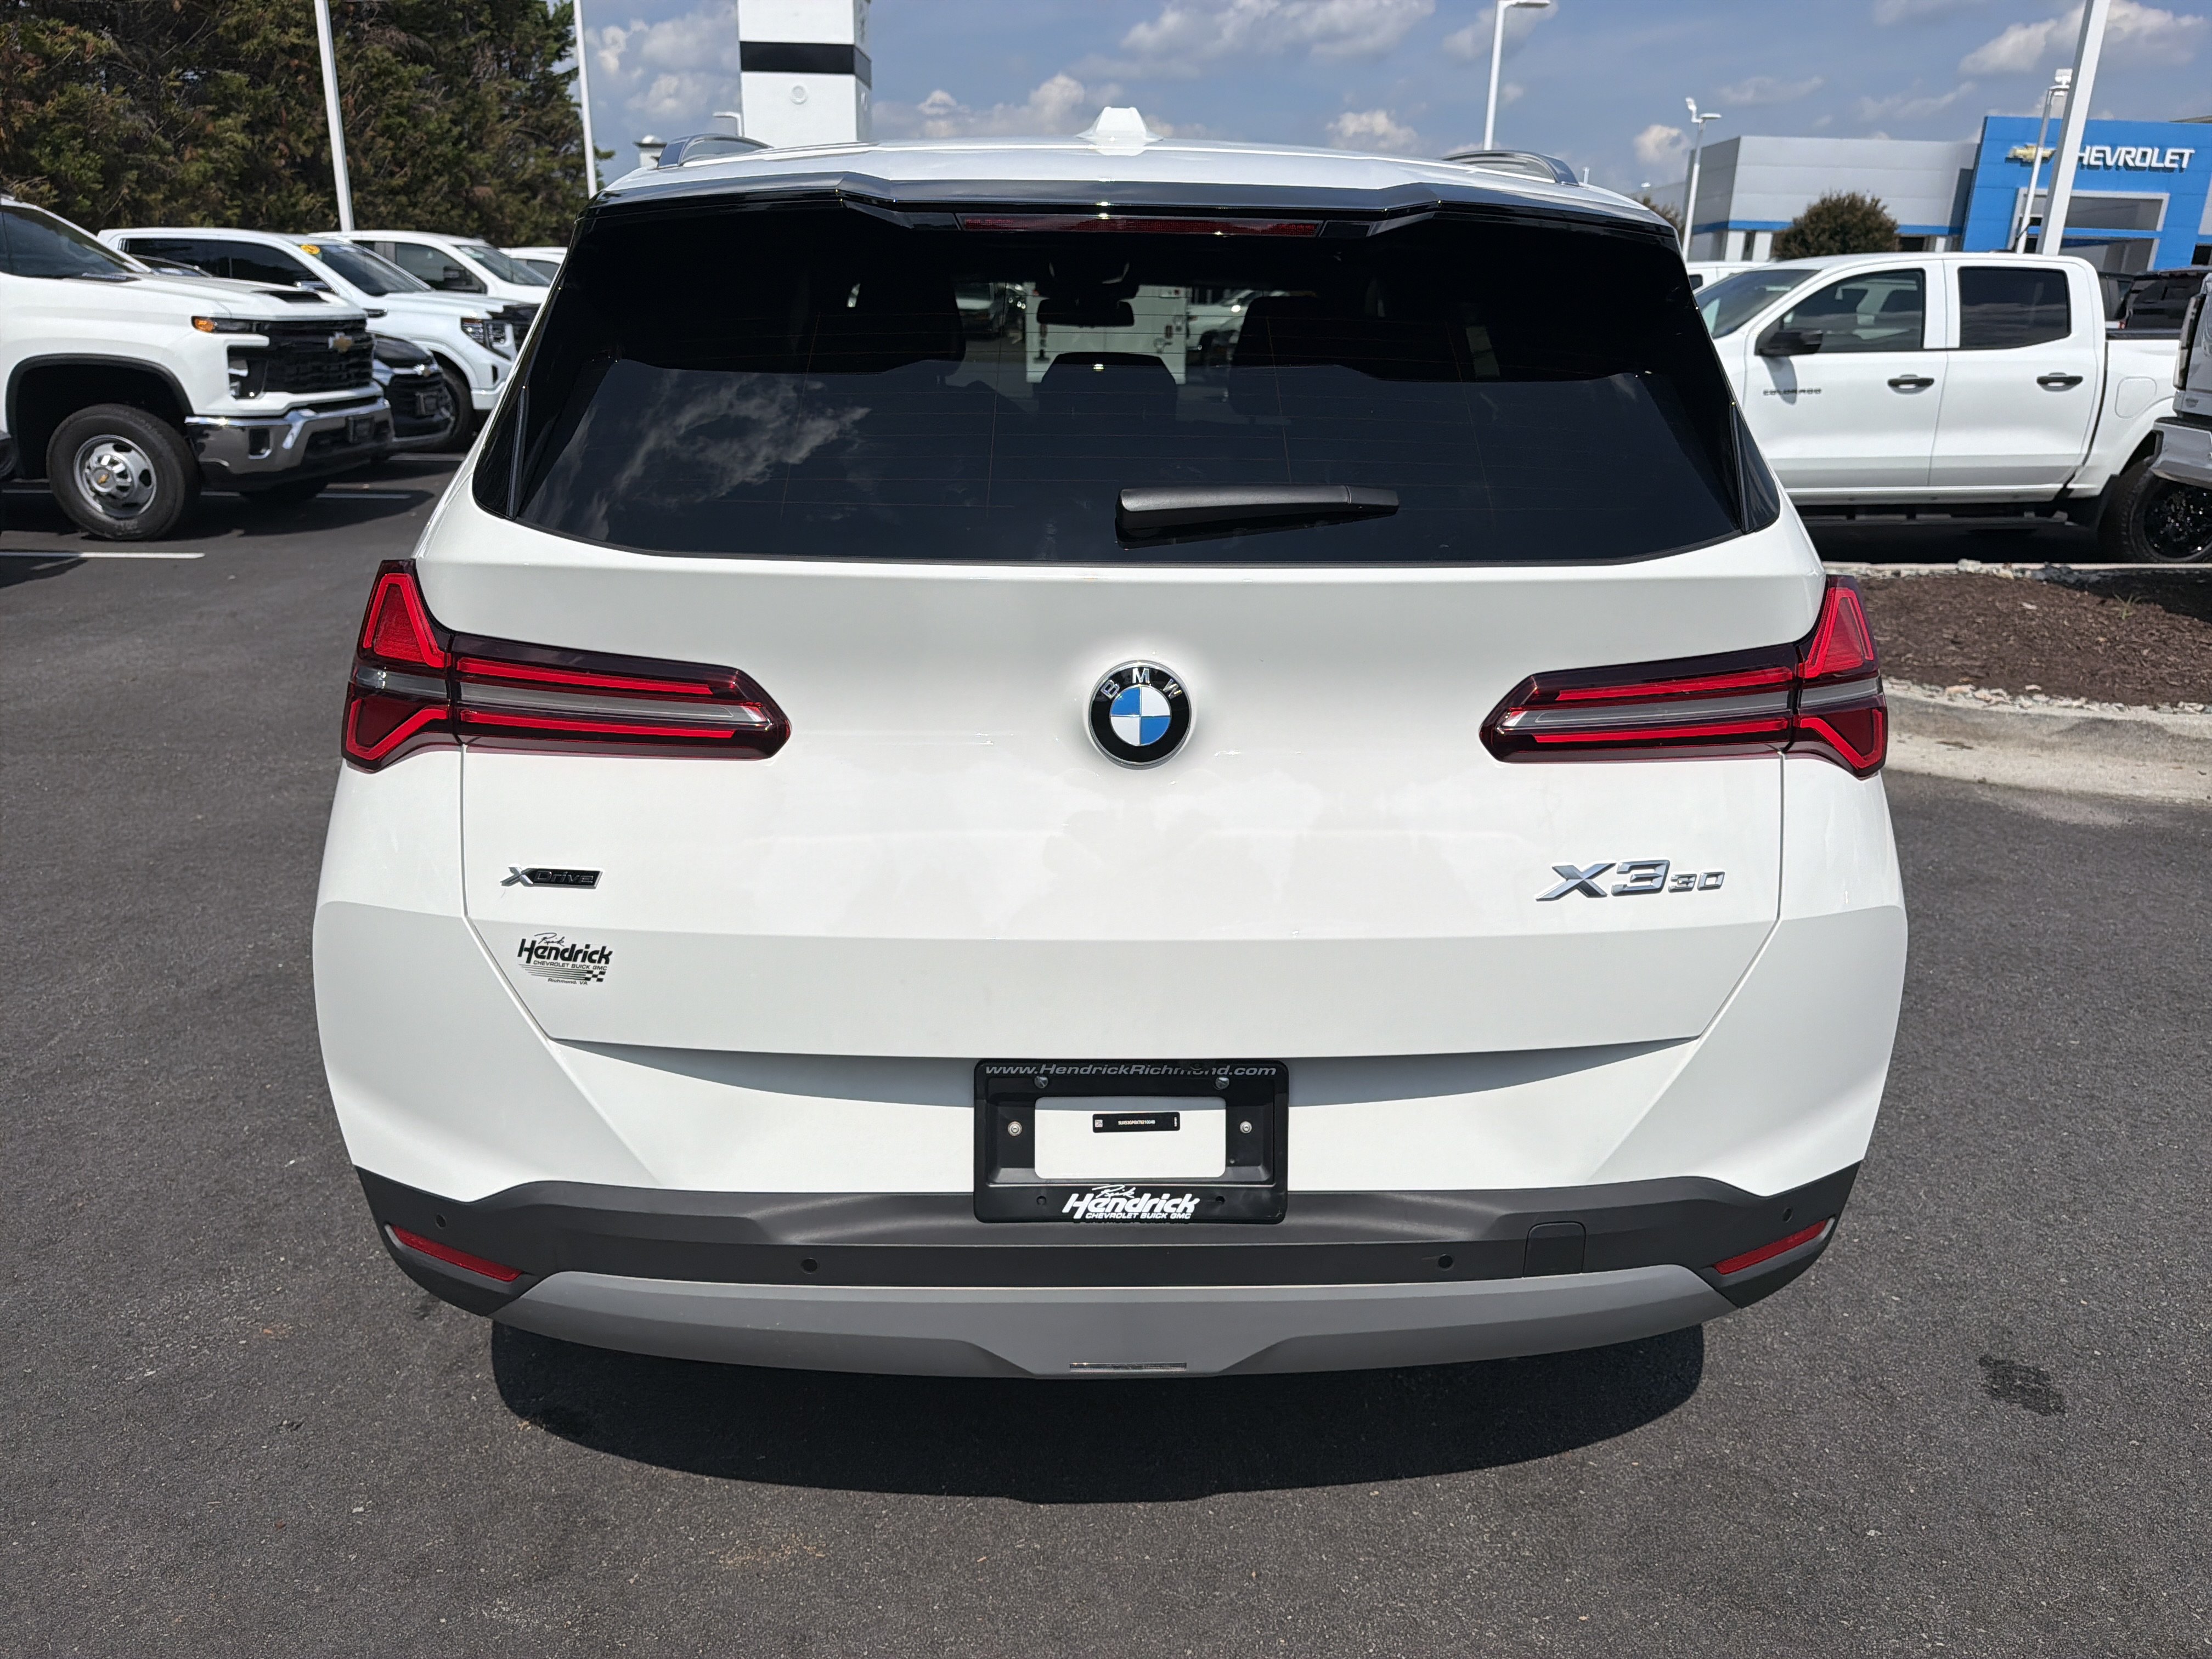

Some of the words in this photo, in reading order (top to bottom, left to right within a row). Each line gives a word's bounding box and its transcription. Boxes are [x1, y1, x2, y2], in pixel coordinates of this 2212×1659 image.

[2078, 144, 2195, 168] HEVROLET
[1100, 667, 1183, 700] BMW
[1536, 858, 1670, 901] X3
[1668, 871, 1725, 893] 30
[517, 938, 613, 964] Hendrick
[1062, 1193, 1200, 1219] Hendrick
